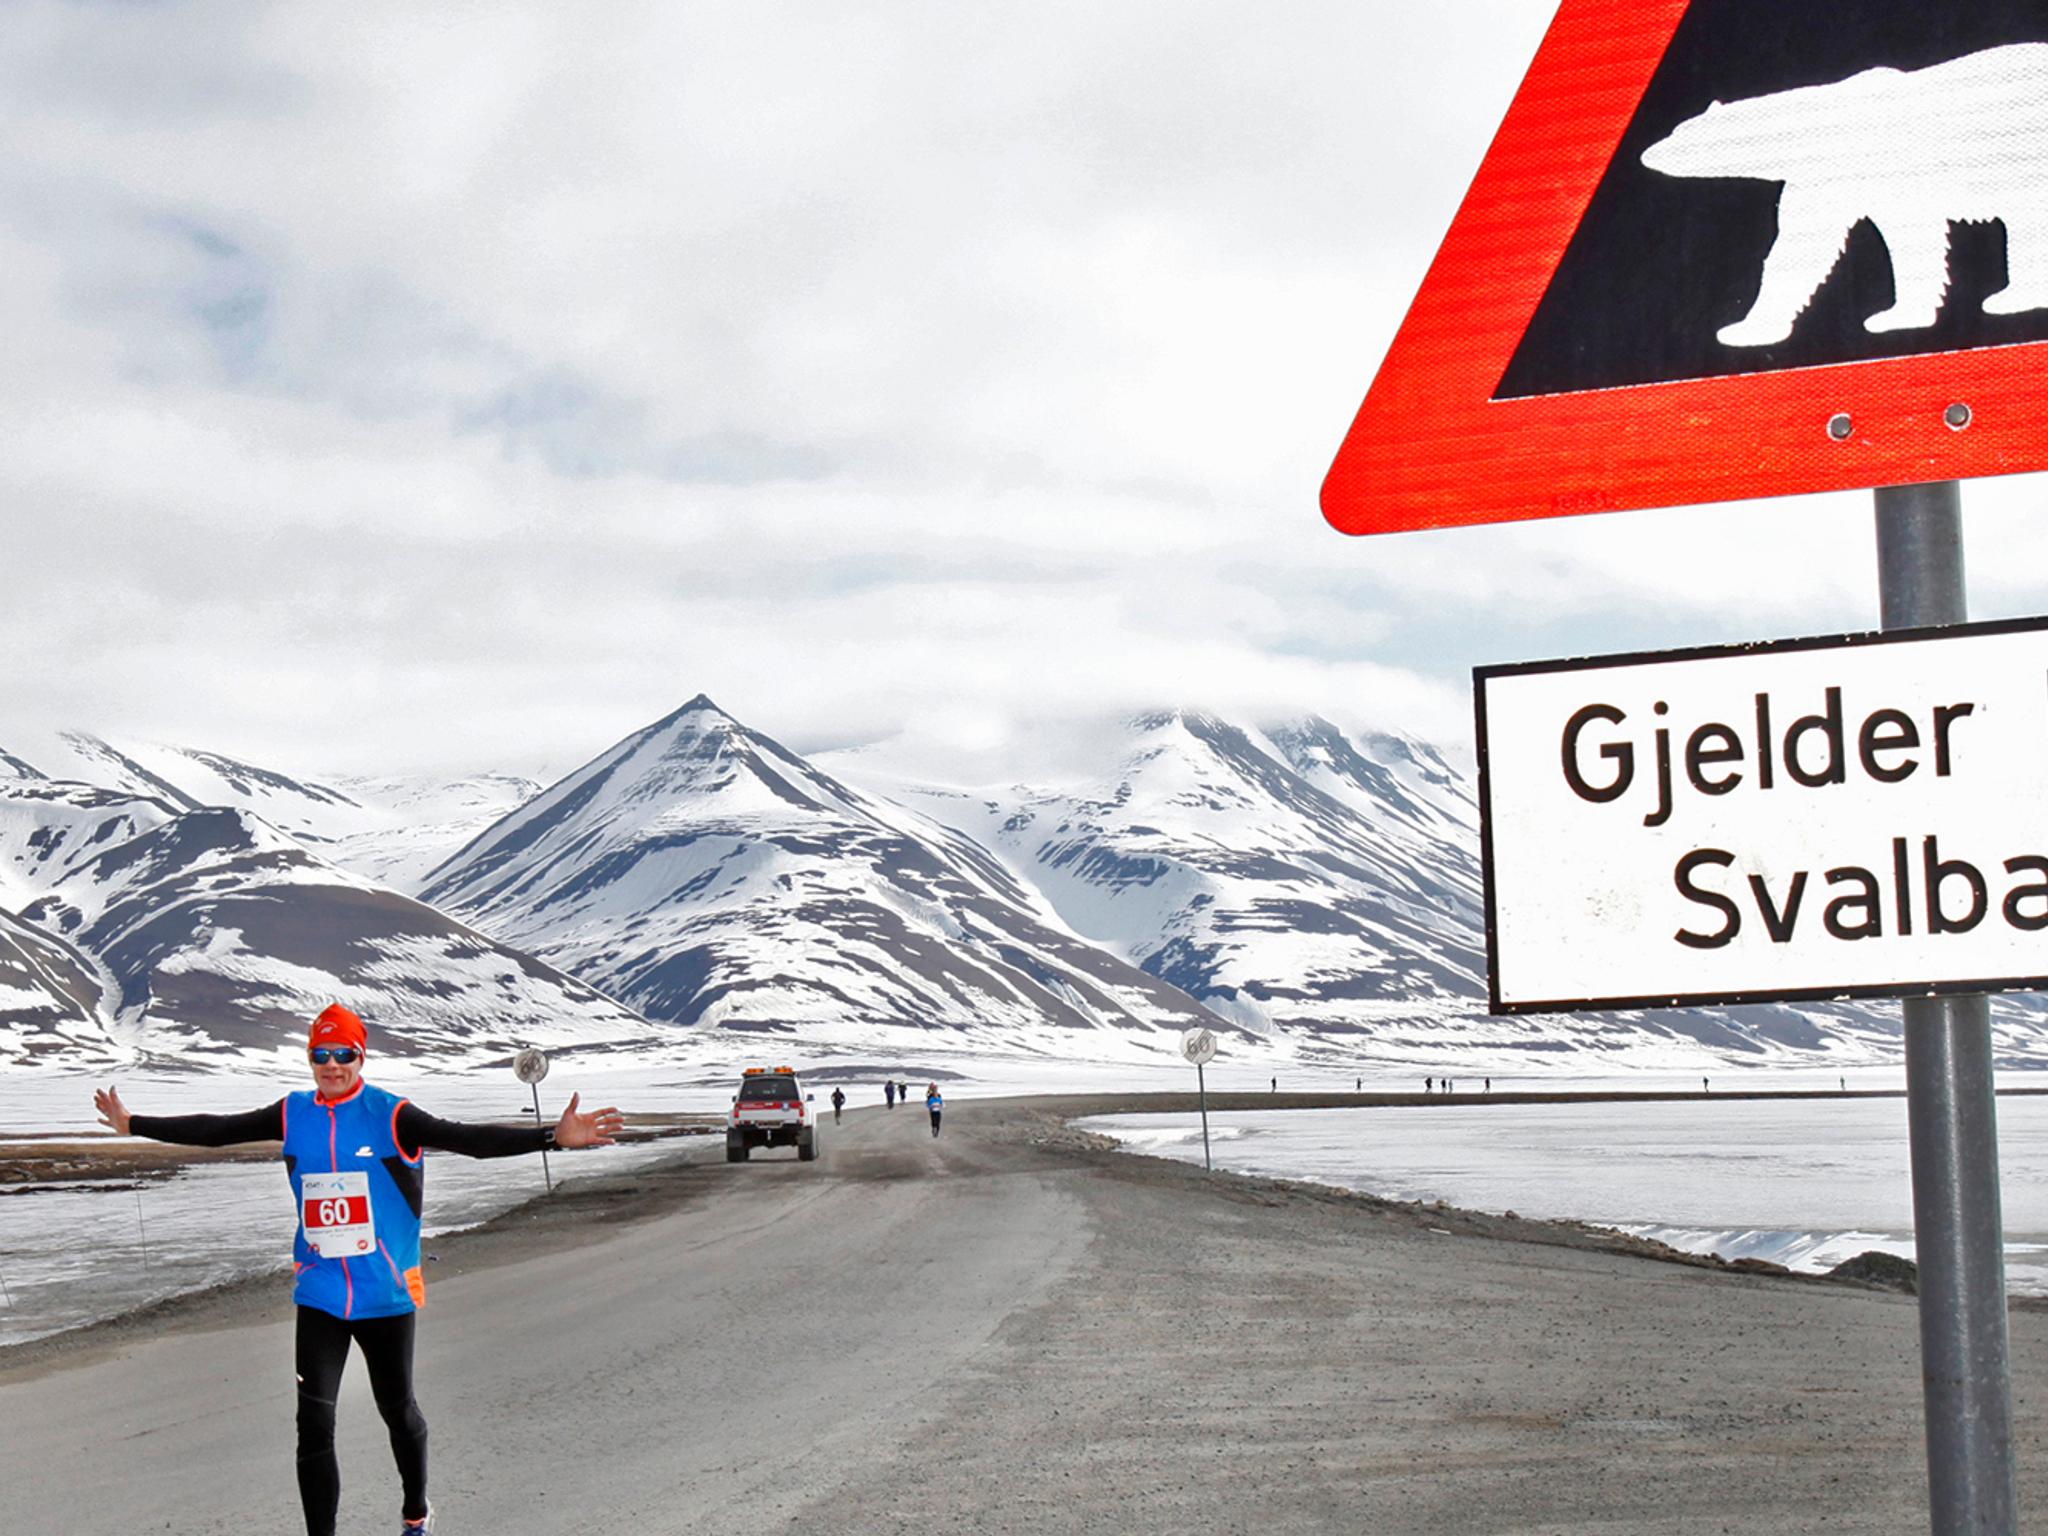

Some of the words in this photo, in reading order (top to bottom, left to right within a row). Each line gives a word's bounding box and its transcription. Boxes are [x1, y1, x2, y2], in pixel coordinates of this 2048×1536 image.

[1561, 687, 1975, 828] Gjelder
[1674, 835, 2048, 949] Svalba
[1186, 1037, 1210, 1055] 60
[319, 1198, 350, 1226] 60
